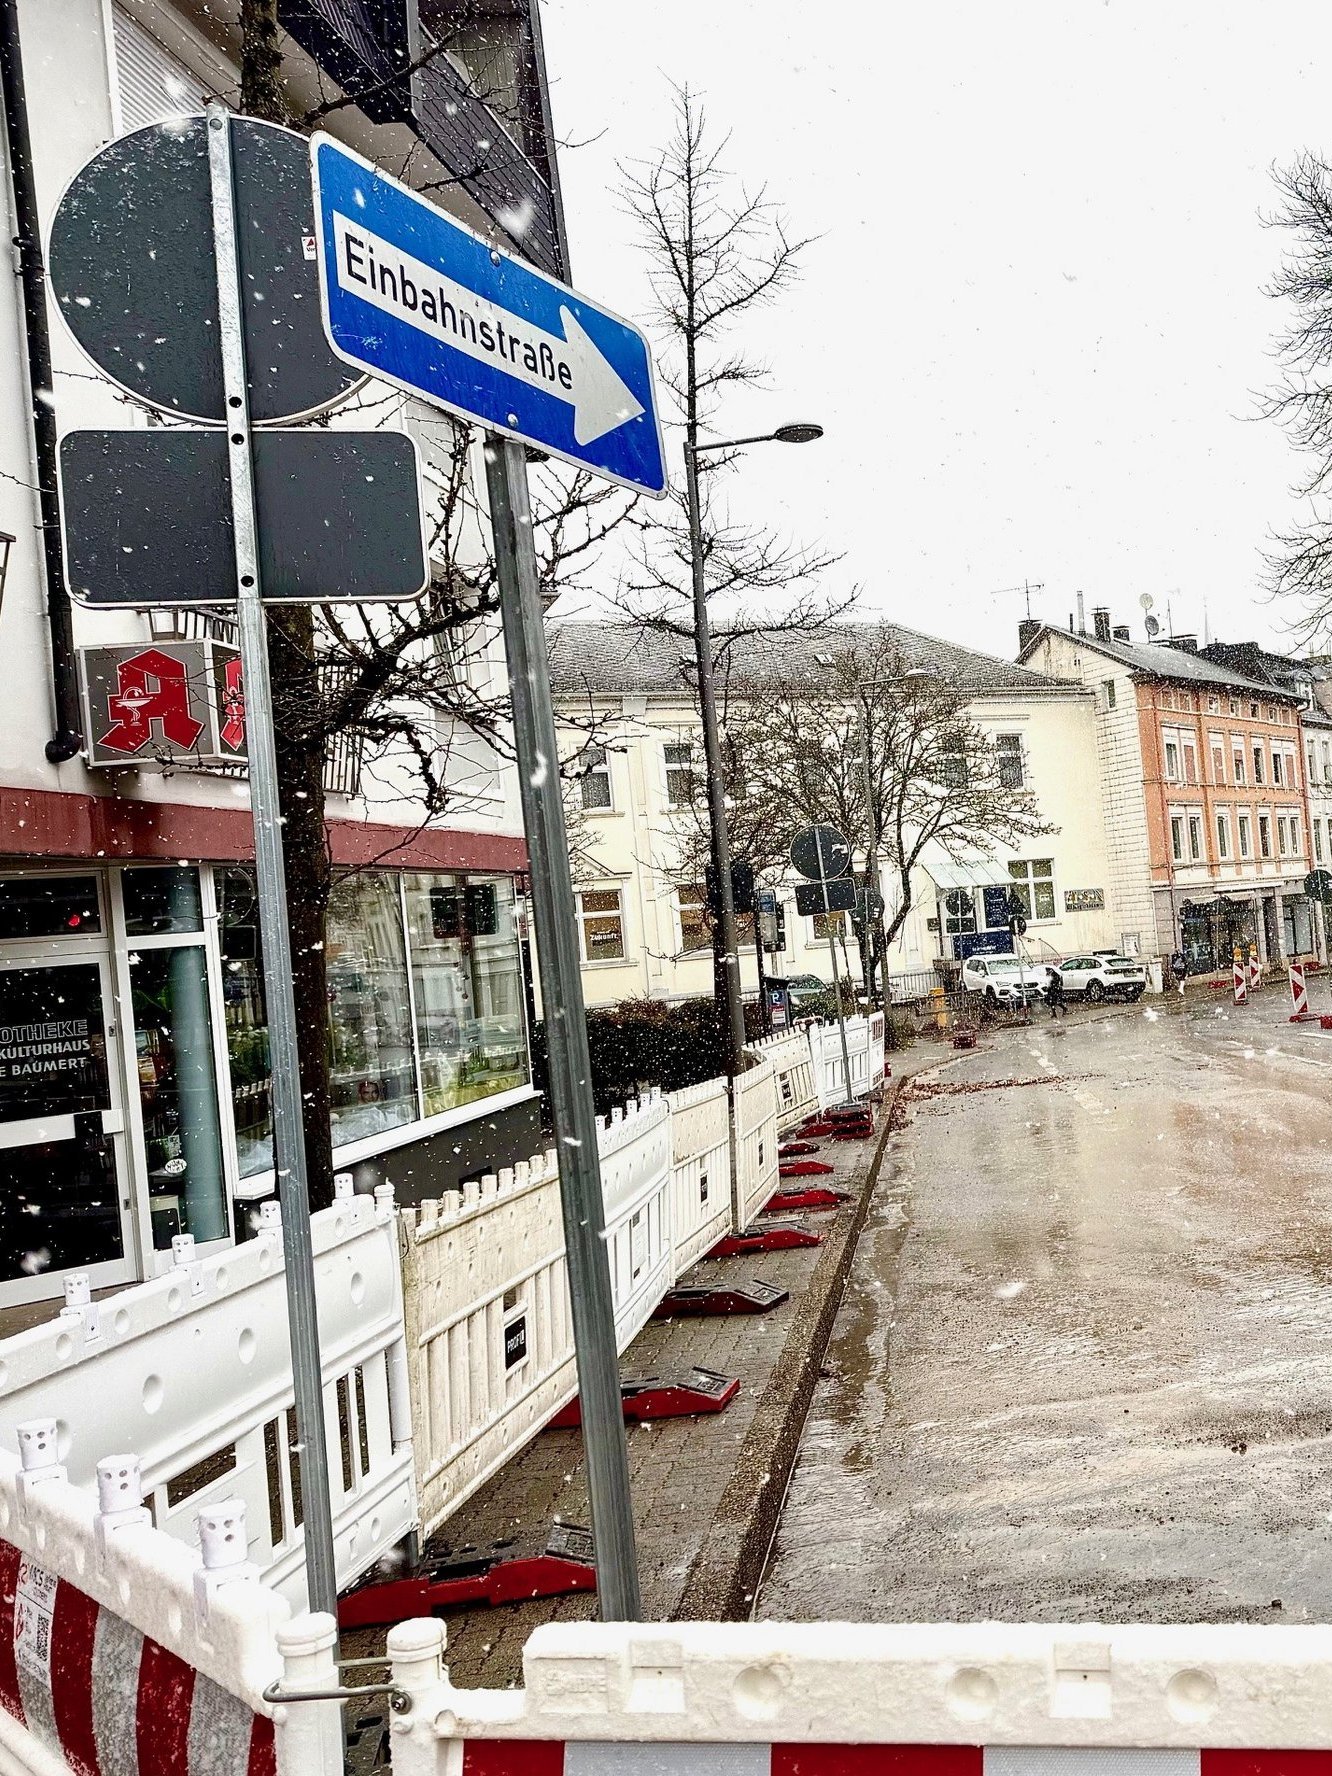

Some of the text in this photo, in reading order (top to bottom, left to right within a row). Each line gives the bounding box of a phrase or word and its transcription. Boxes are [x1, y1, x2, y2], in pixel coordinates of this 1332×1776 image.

[344, 231, 573, 390] Einbahnstraße
[0, 1019, 88, 1044] OTHEKE
[0, 1039, 91, 1060] KULTURHAUS
[12, 1057, 87, 1076] BAUMERT
